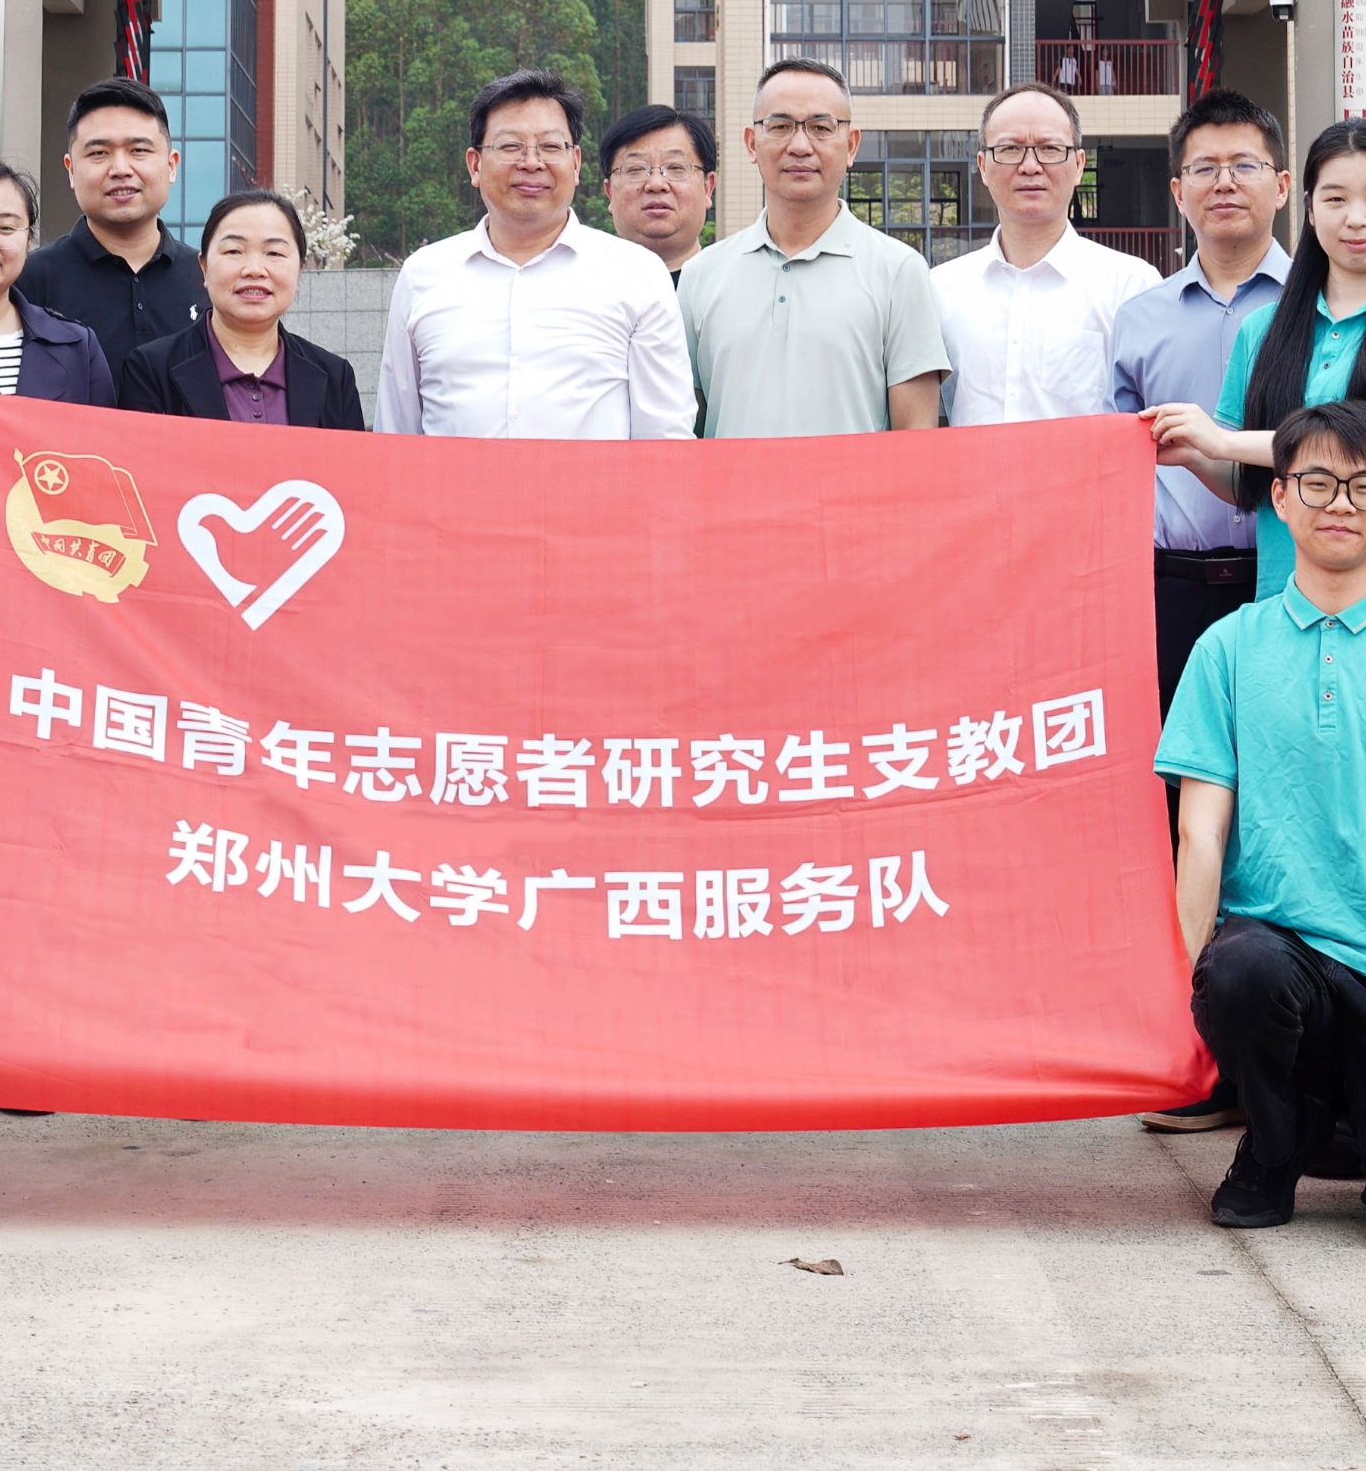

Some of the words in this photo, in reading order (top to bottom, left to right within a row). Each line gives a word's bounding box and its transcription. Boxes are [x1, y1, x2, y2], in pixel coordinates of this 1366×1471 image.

[10, 668, 1107, 808] 中国青年志愿者研究生支教团
[165, 820, 950, 940] 郑州大学广西服务队
